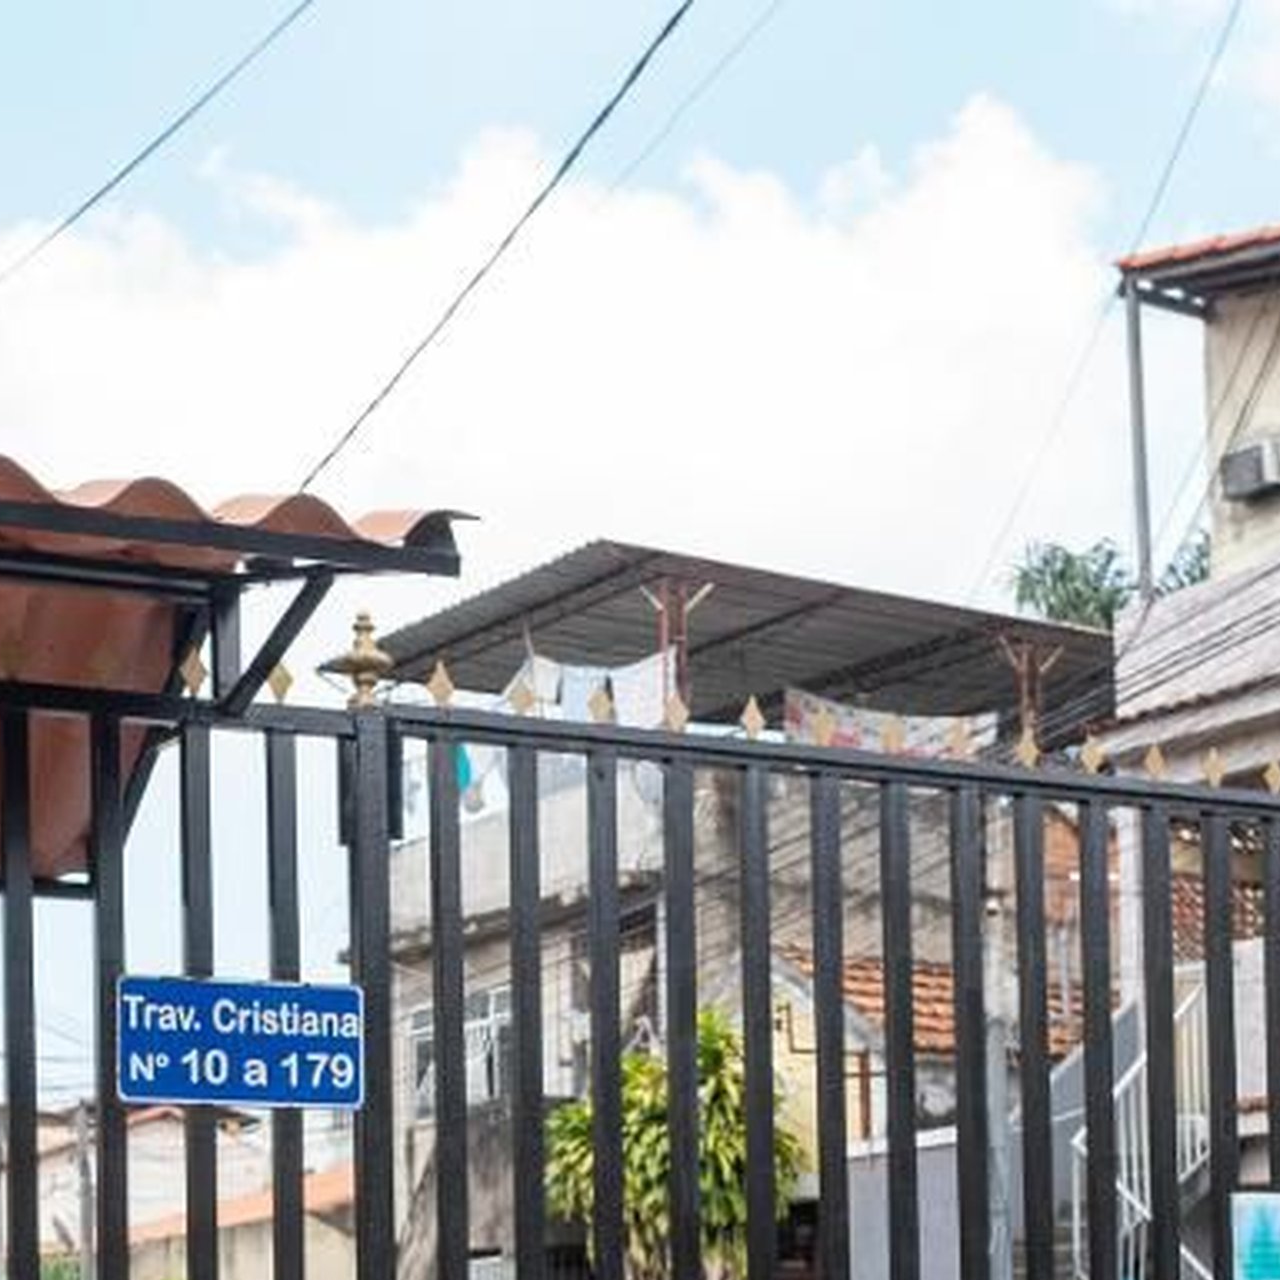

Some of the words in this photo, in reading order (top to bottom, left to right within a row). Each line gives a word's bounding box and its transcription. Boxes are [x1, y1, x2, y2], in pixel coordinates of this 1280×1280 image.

[123, 994, 201, 1032] Trav.
[212, 998, 358, 1038] Cristiana
[181, 1048, 228, 1085] 10
[243, 1058, 268, 1087] a
[281, 1053, 355, 1088] 179
